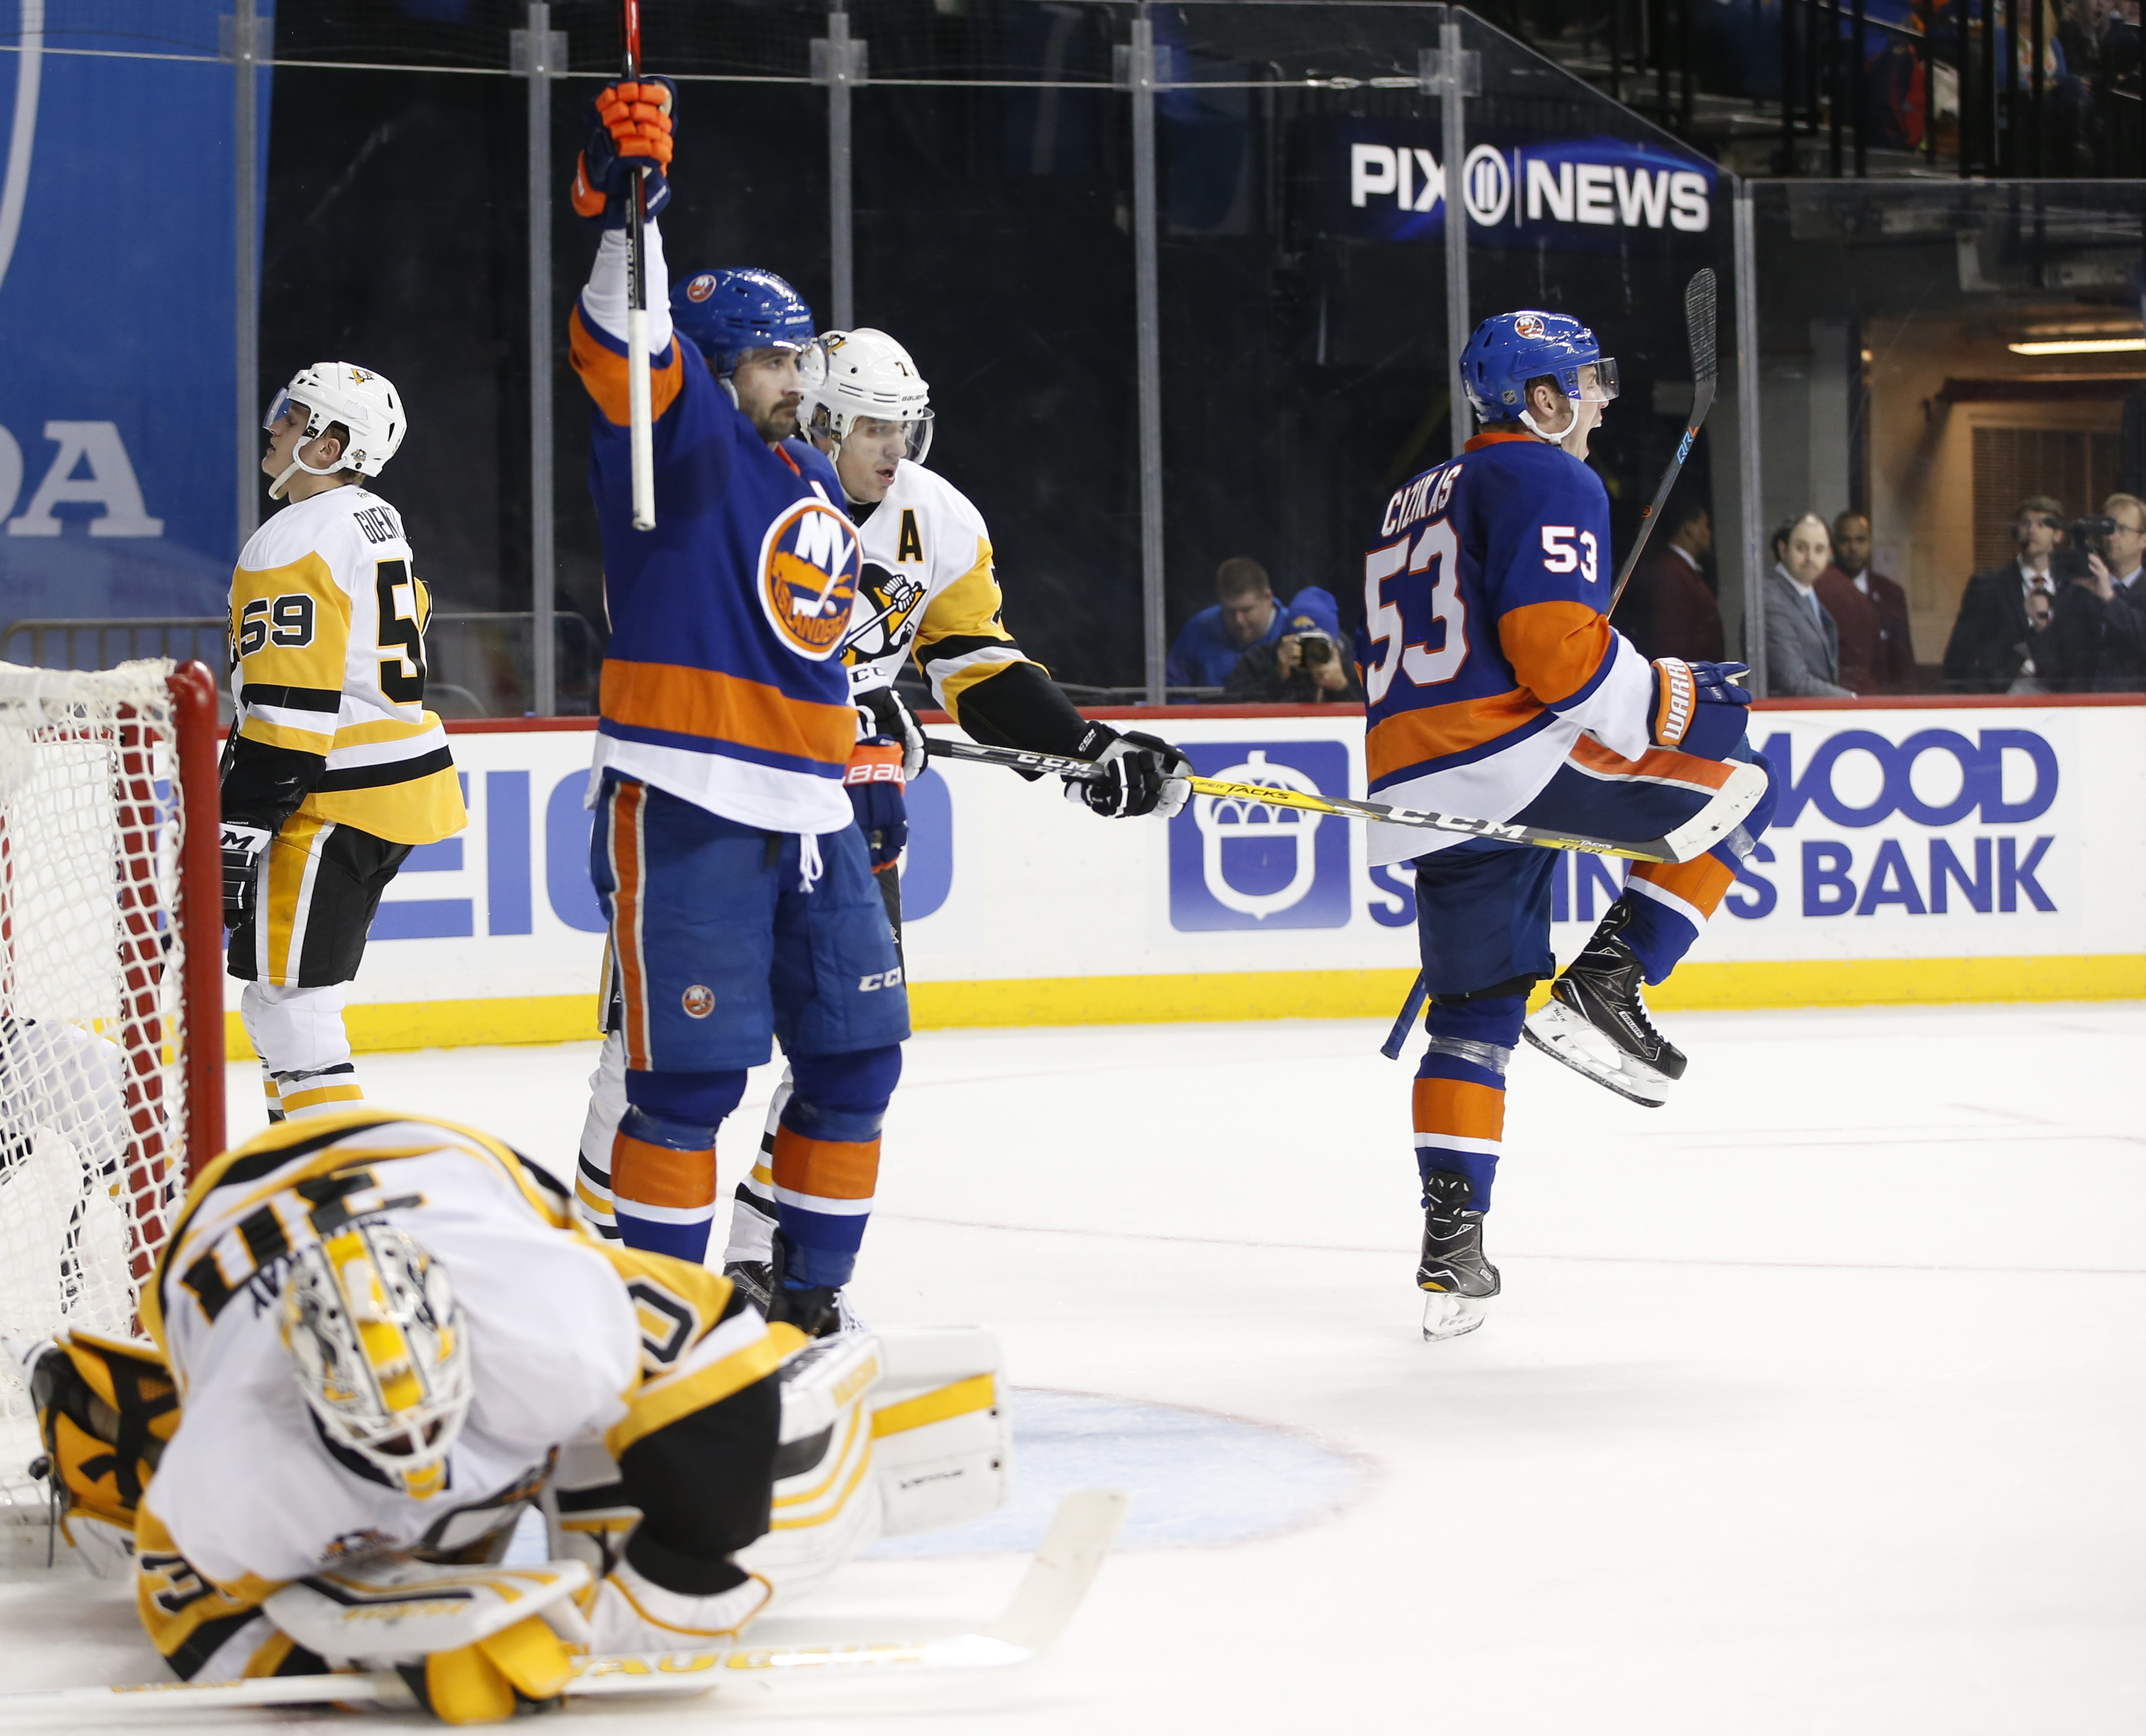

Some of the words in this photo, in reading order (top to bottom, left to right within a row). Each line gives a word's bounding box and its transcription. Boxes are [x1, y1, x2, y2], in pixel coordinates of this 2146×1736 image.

[1351, 143, 1446, 213] PIX
[1526, 159, 1710, 231] NEWS
[0, 420, 165, 537] A
[1381, 463, 1463, 538] CIZIKAS
[897, 508, 925, 564] A
[1541, 524, 1598, 584] 53
[239, 593, 316, 658] 59
[1364, 514, 1470, 707] 53
[849, 666, 887, 683] CC
[1017, 753, 1092, 772] CCM
[1225, 783, 1290, 800] TACKS
[1387, 806, 1528, 839] CCM
[1578, 839, 1614, 849] TACKS
[1801, 836, 2057, 918] BANK
[1619, 1011, 1645, 1038] BAUER
